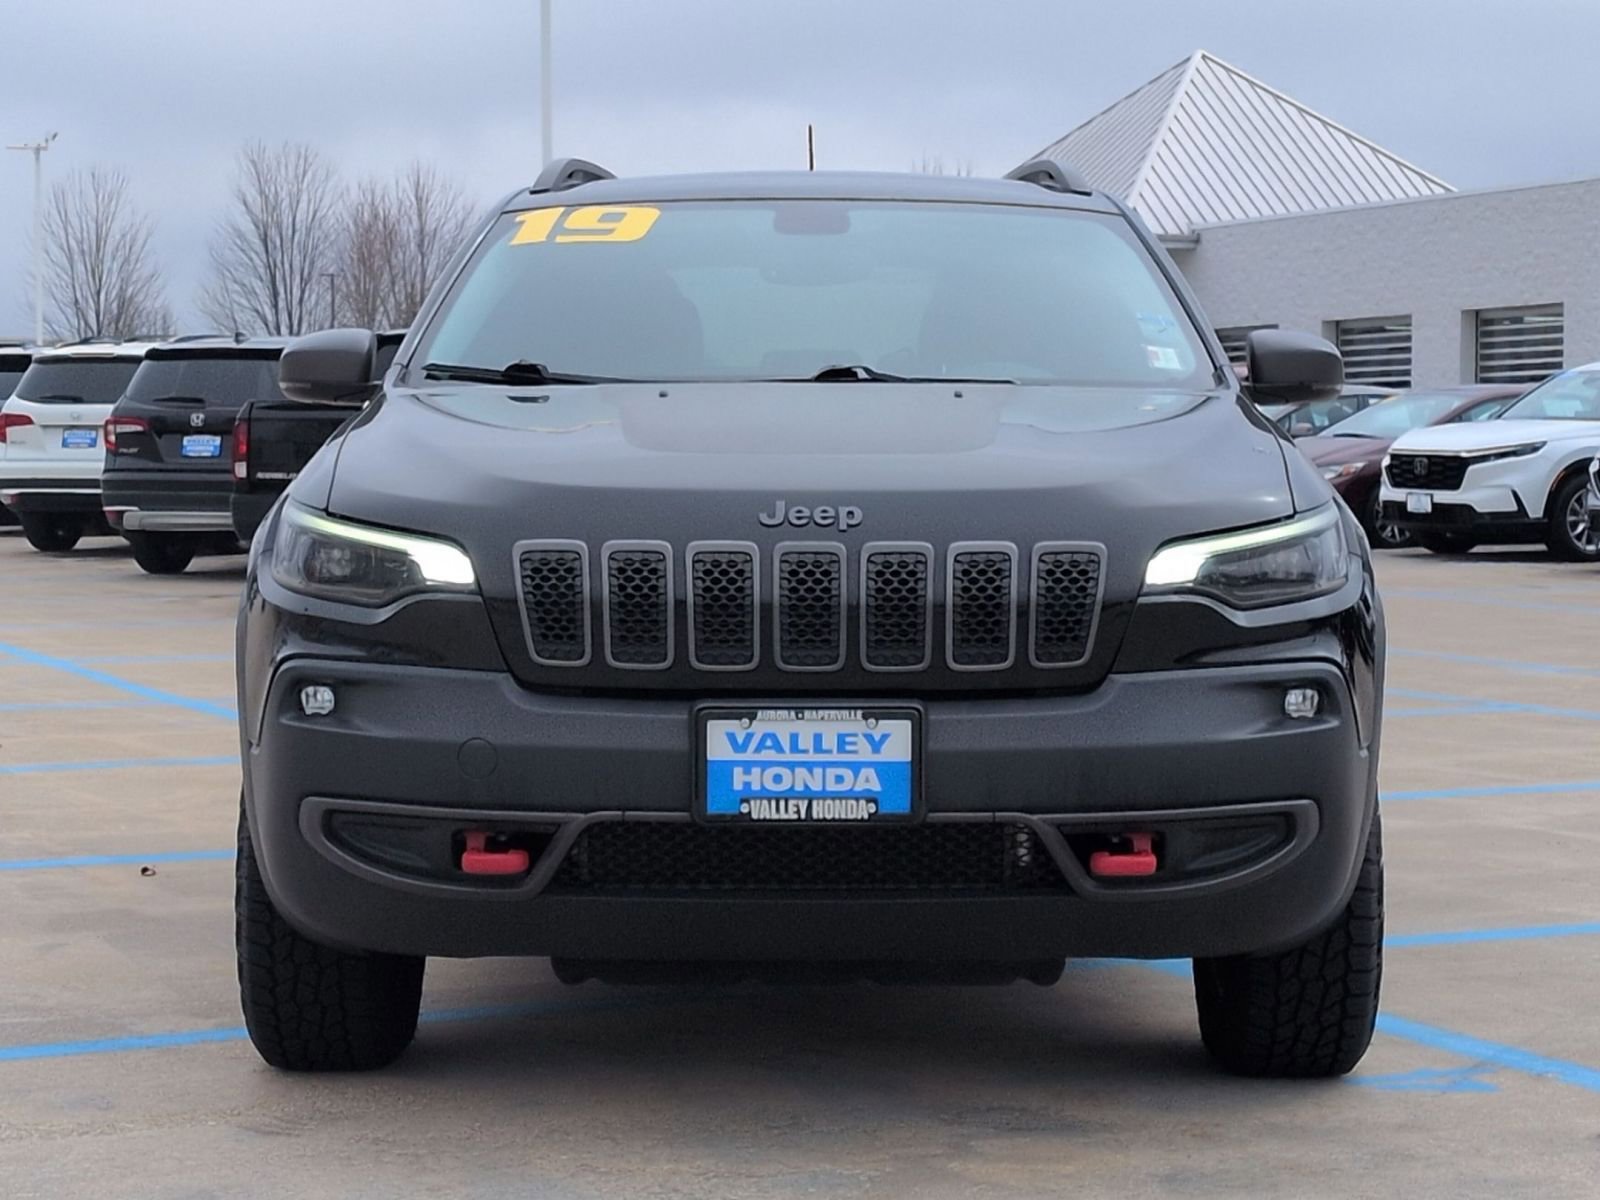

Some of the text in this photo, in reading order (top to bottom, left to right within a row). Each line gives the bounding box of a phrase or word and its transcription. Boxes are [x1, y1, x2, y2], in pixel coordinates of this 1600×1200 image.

[509, 206, 661, 245] 19
[758, 500, 864, 532] Jeep
[756, 709, 864, 721] AURORA NAPERVILLE
[725, 732, 891, 754] VALLEY
[733, 766, 882, 792] HONDA
[750, 799, 869, 820] VALLEY HONDA
